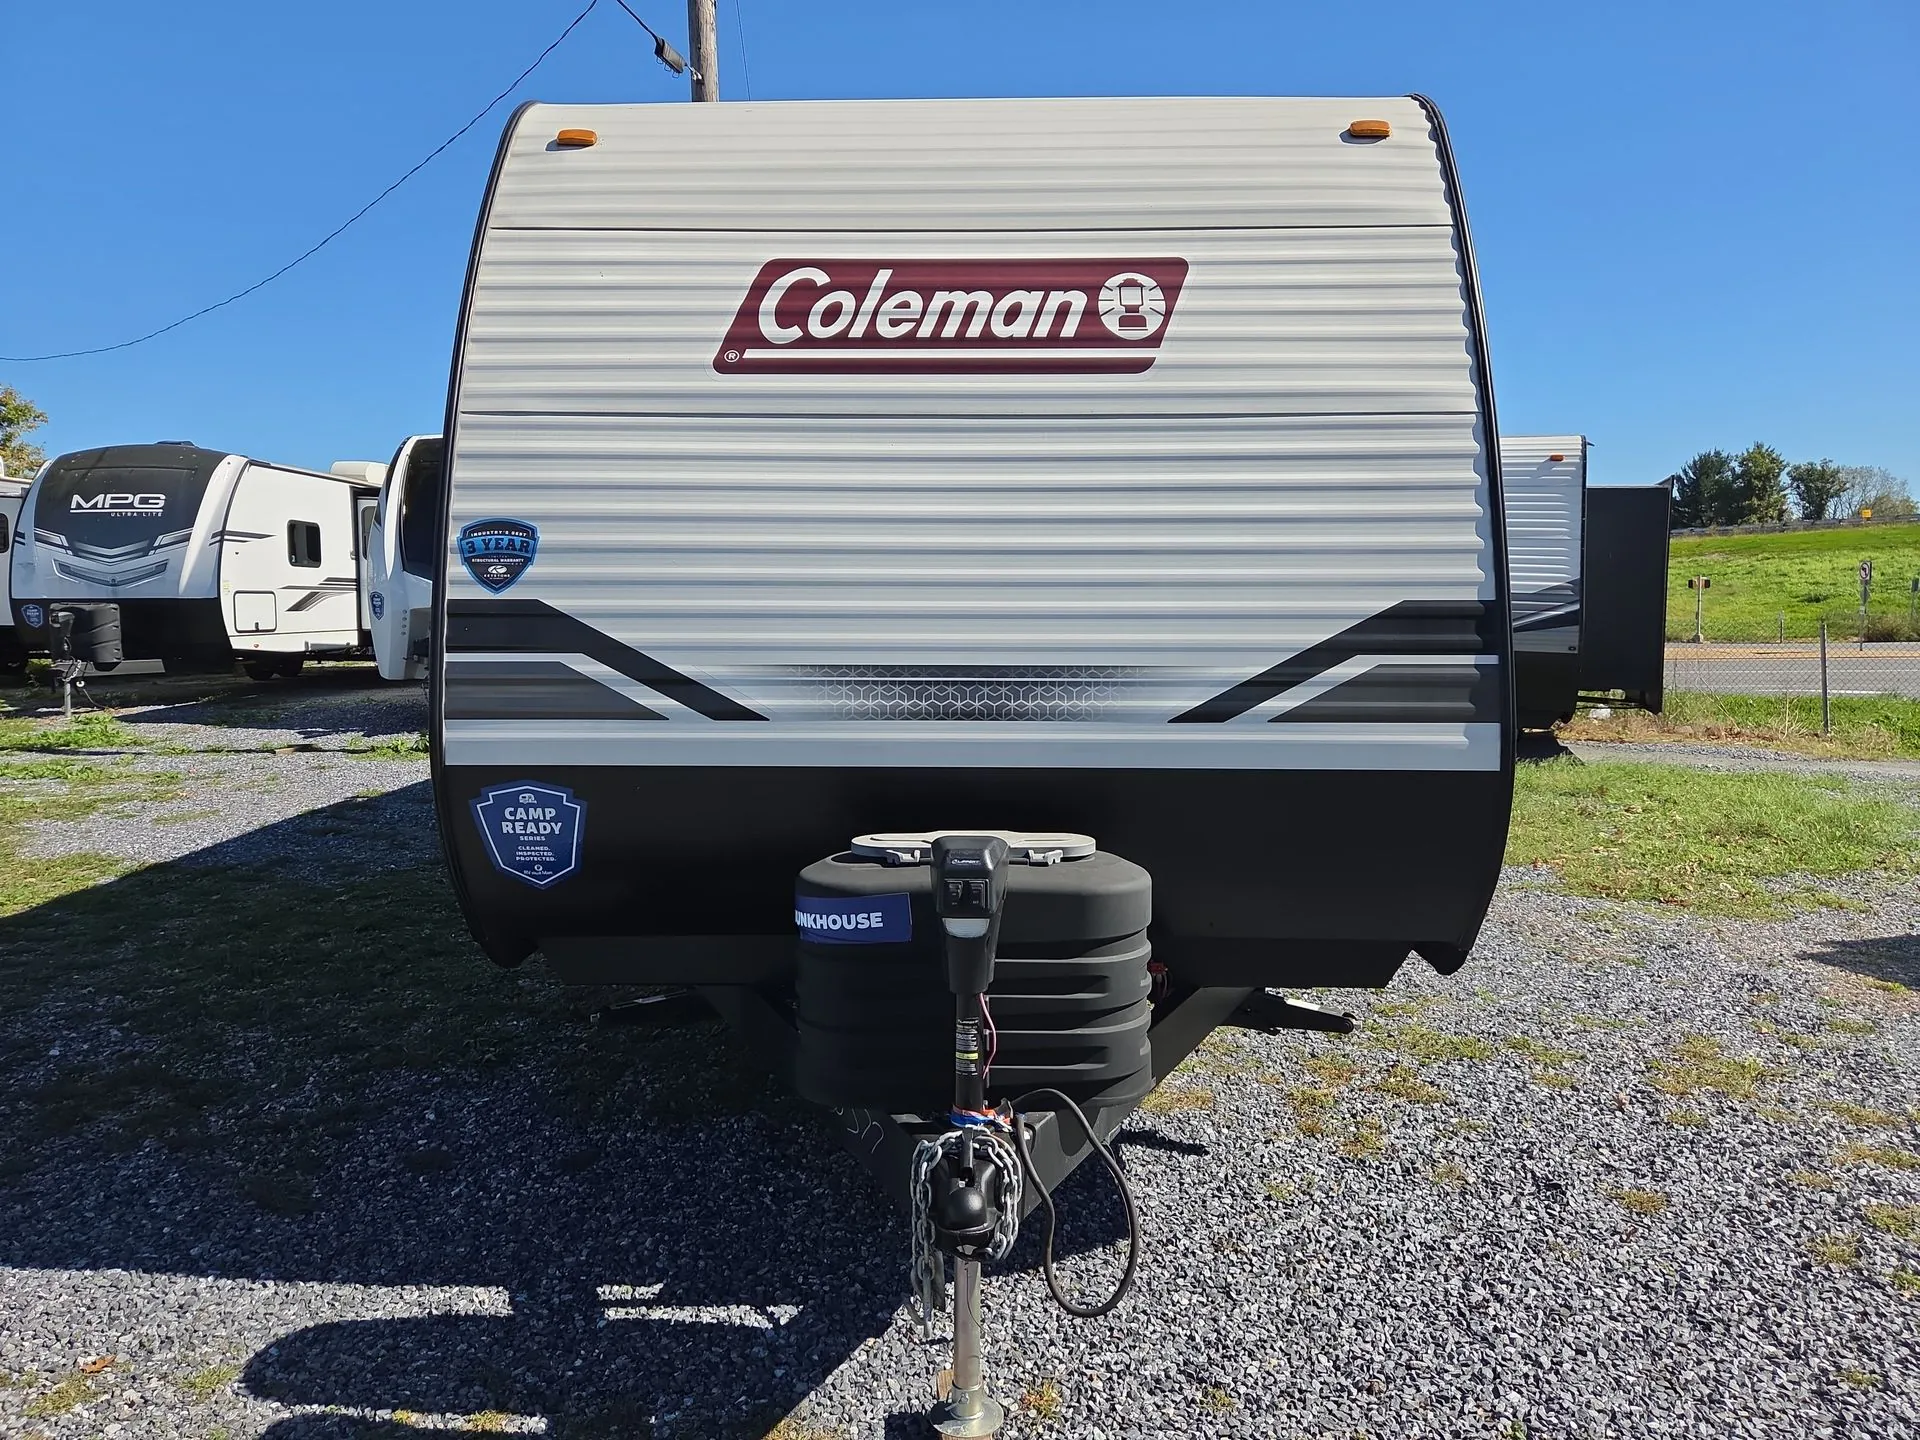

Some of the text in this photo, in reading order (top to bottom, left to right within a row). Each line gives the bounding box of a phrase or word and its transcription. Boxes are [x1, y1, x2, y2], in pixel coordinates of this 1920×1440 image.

[758, 267, 1088, 344] Coleman
[70, 494, 166, 508] MPG
[466, 538, 531, 554] 3 YEAR
[504, 807, 556, 820] CAMP
[501, 821, 562, 835] READY
[795, 910, 884, 930] UNKHOUSE
